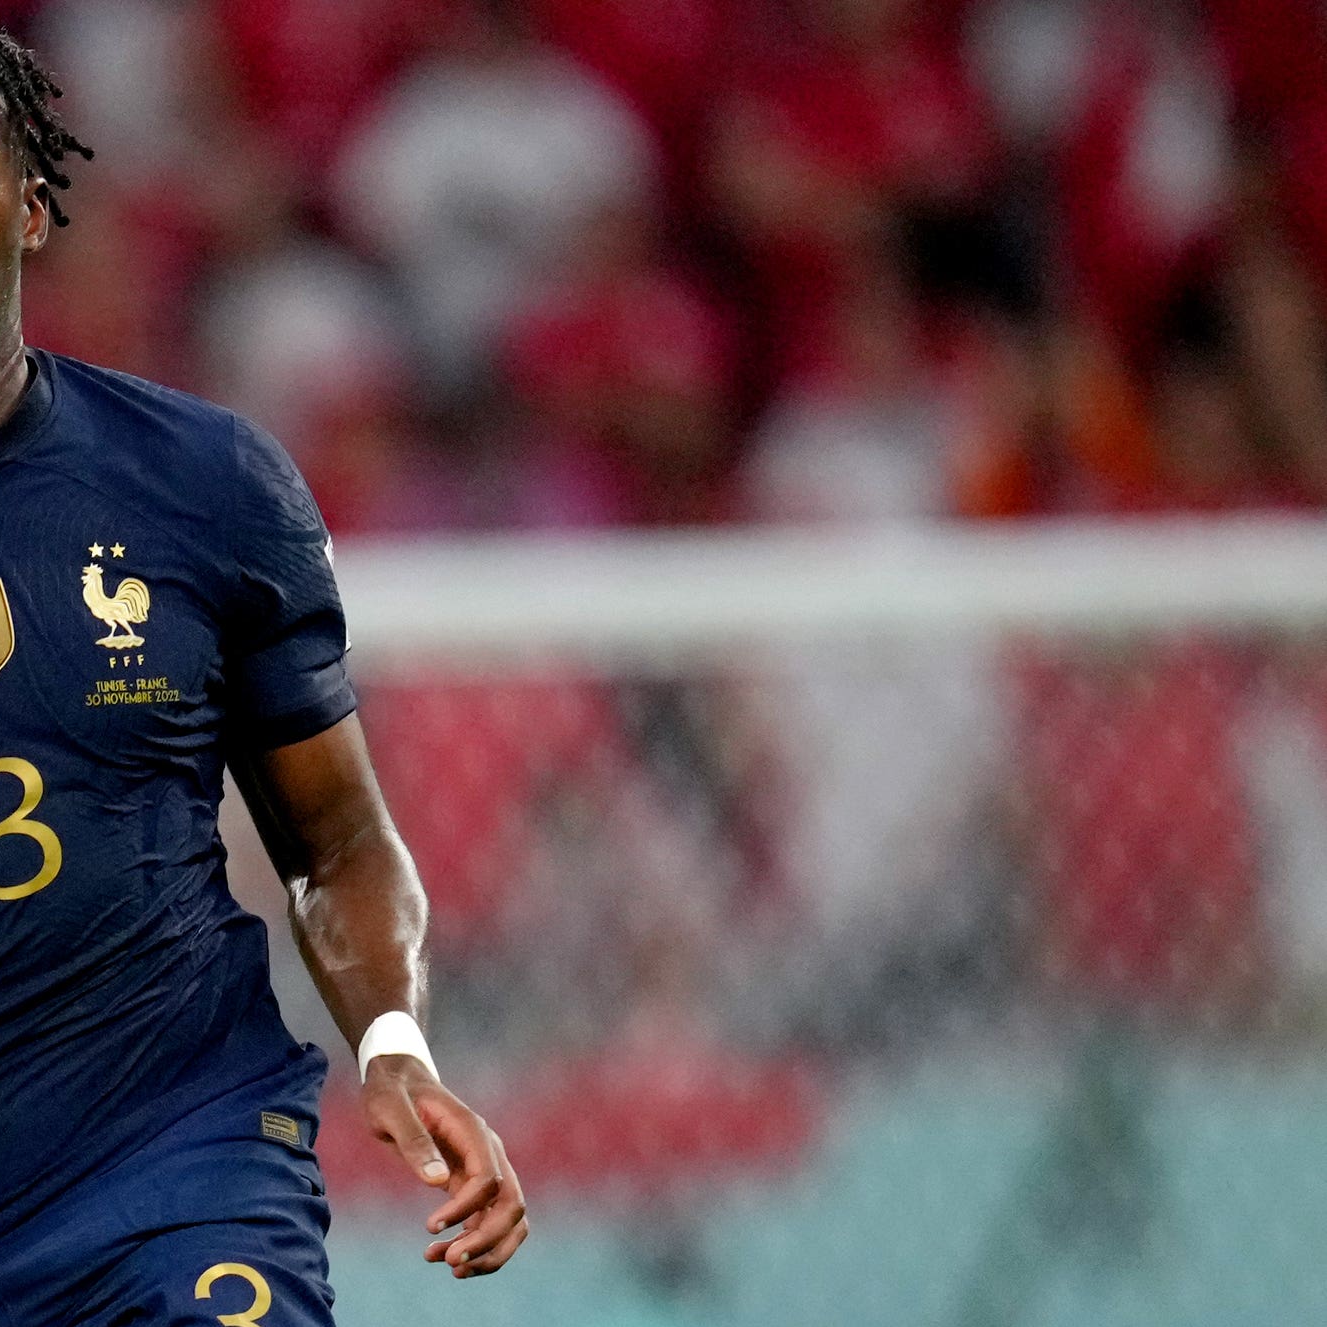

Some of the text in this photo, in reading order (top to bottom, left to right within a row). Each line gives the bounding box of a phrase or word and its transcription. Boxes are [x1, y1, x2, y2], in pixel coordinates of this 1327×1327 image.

[96, 679, 127, 693] TUNISIE
[136, 676, 168, 690] FRANCE
[85, 689, 181, 707] 30 NOVEMBRE 2022
